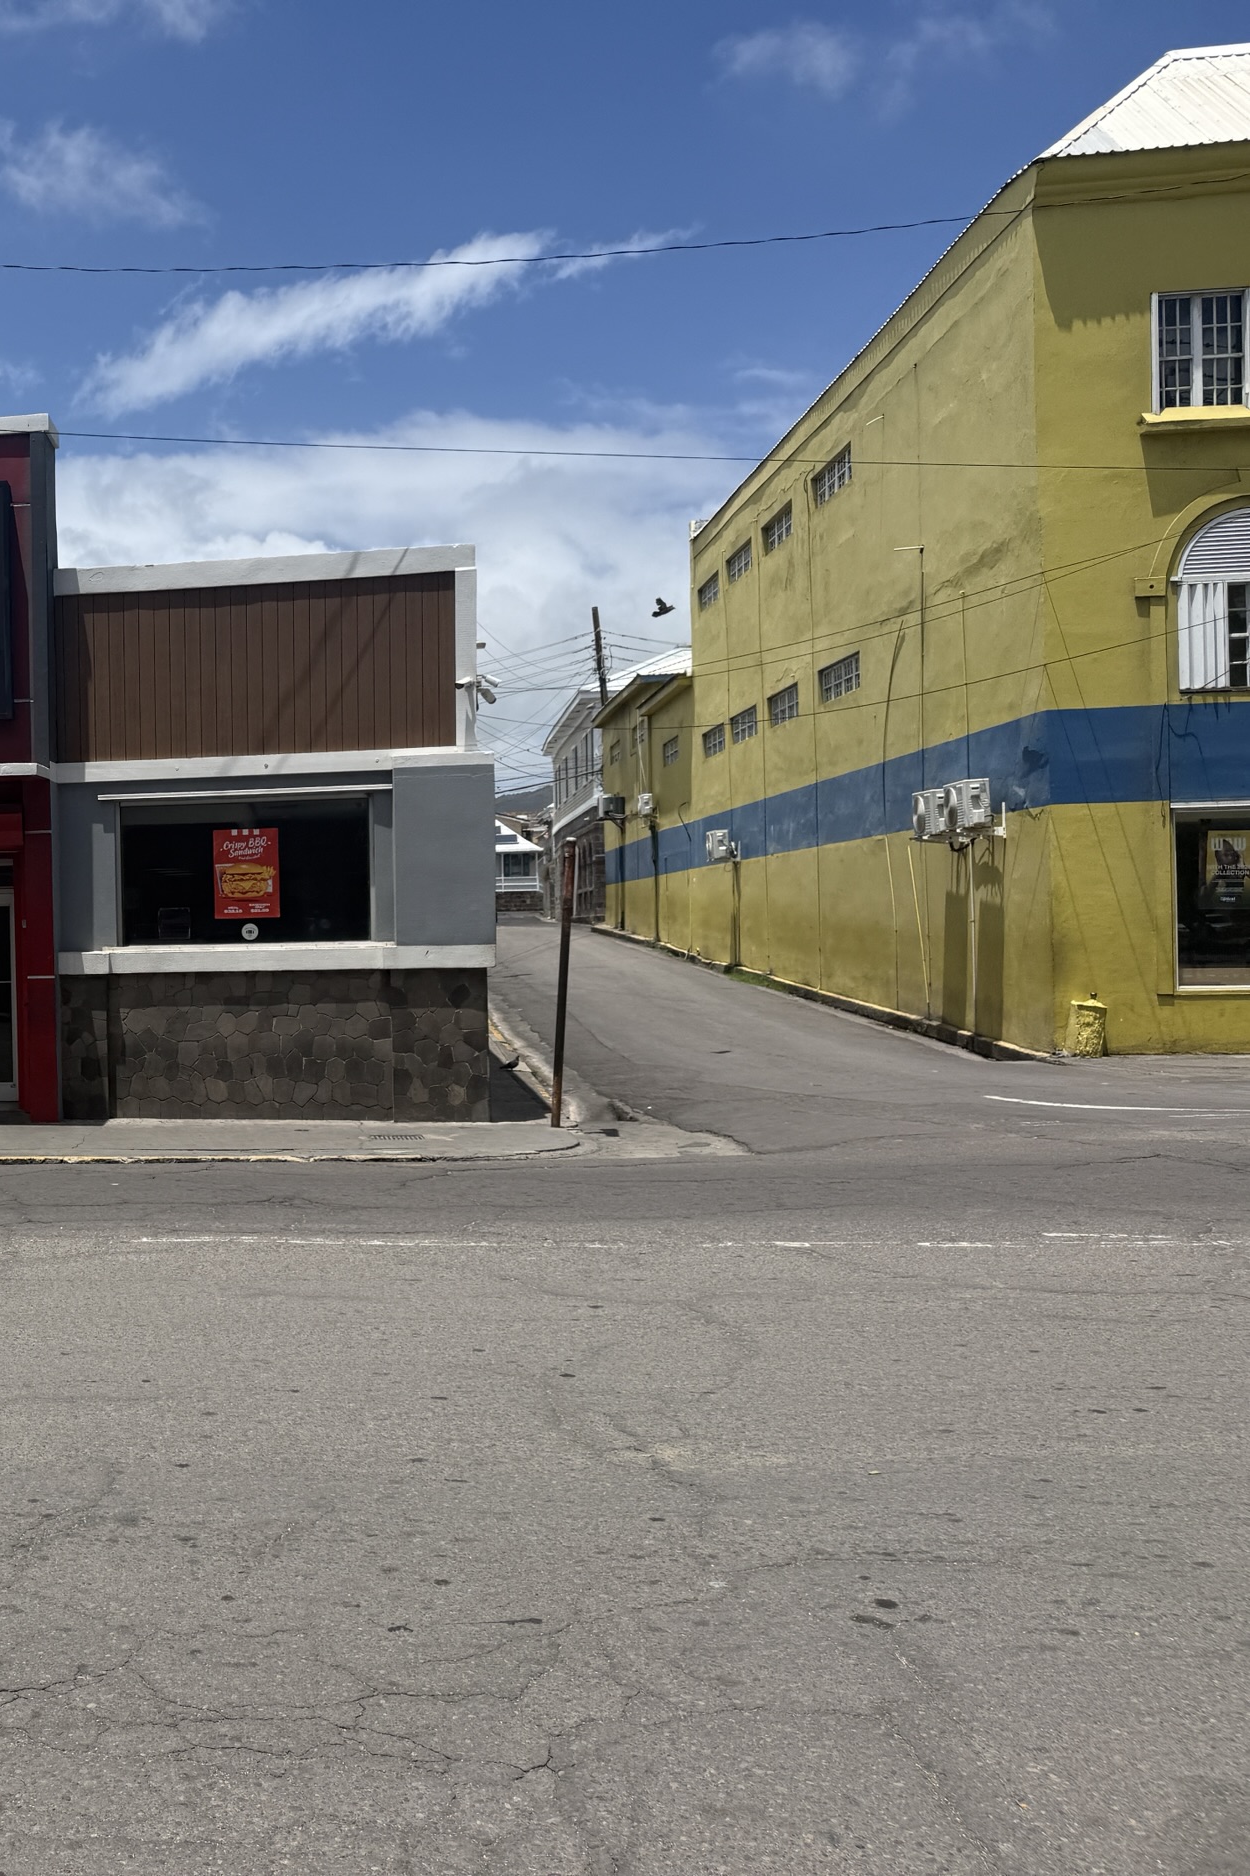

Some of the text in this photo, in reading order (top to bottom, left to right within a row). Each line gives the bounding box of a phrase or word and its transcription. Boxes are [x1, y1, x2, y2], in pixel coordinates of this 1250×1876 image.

[223, 836, 268, 850] Crispy BBQ
[228, 846, 263, 858] Sandwich
